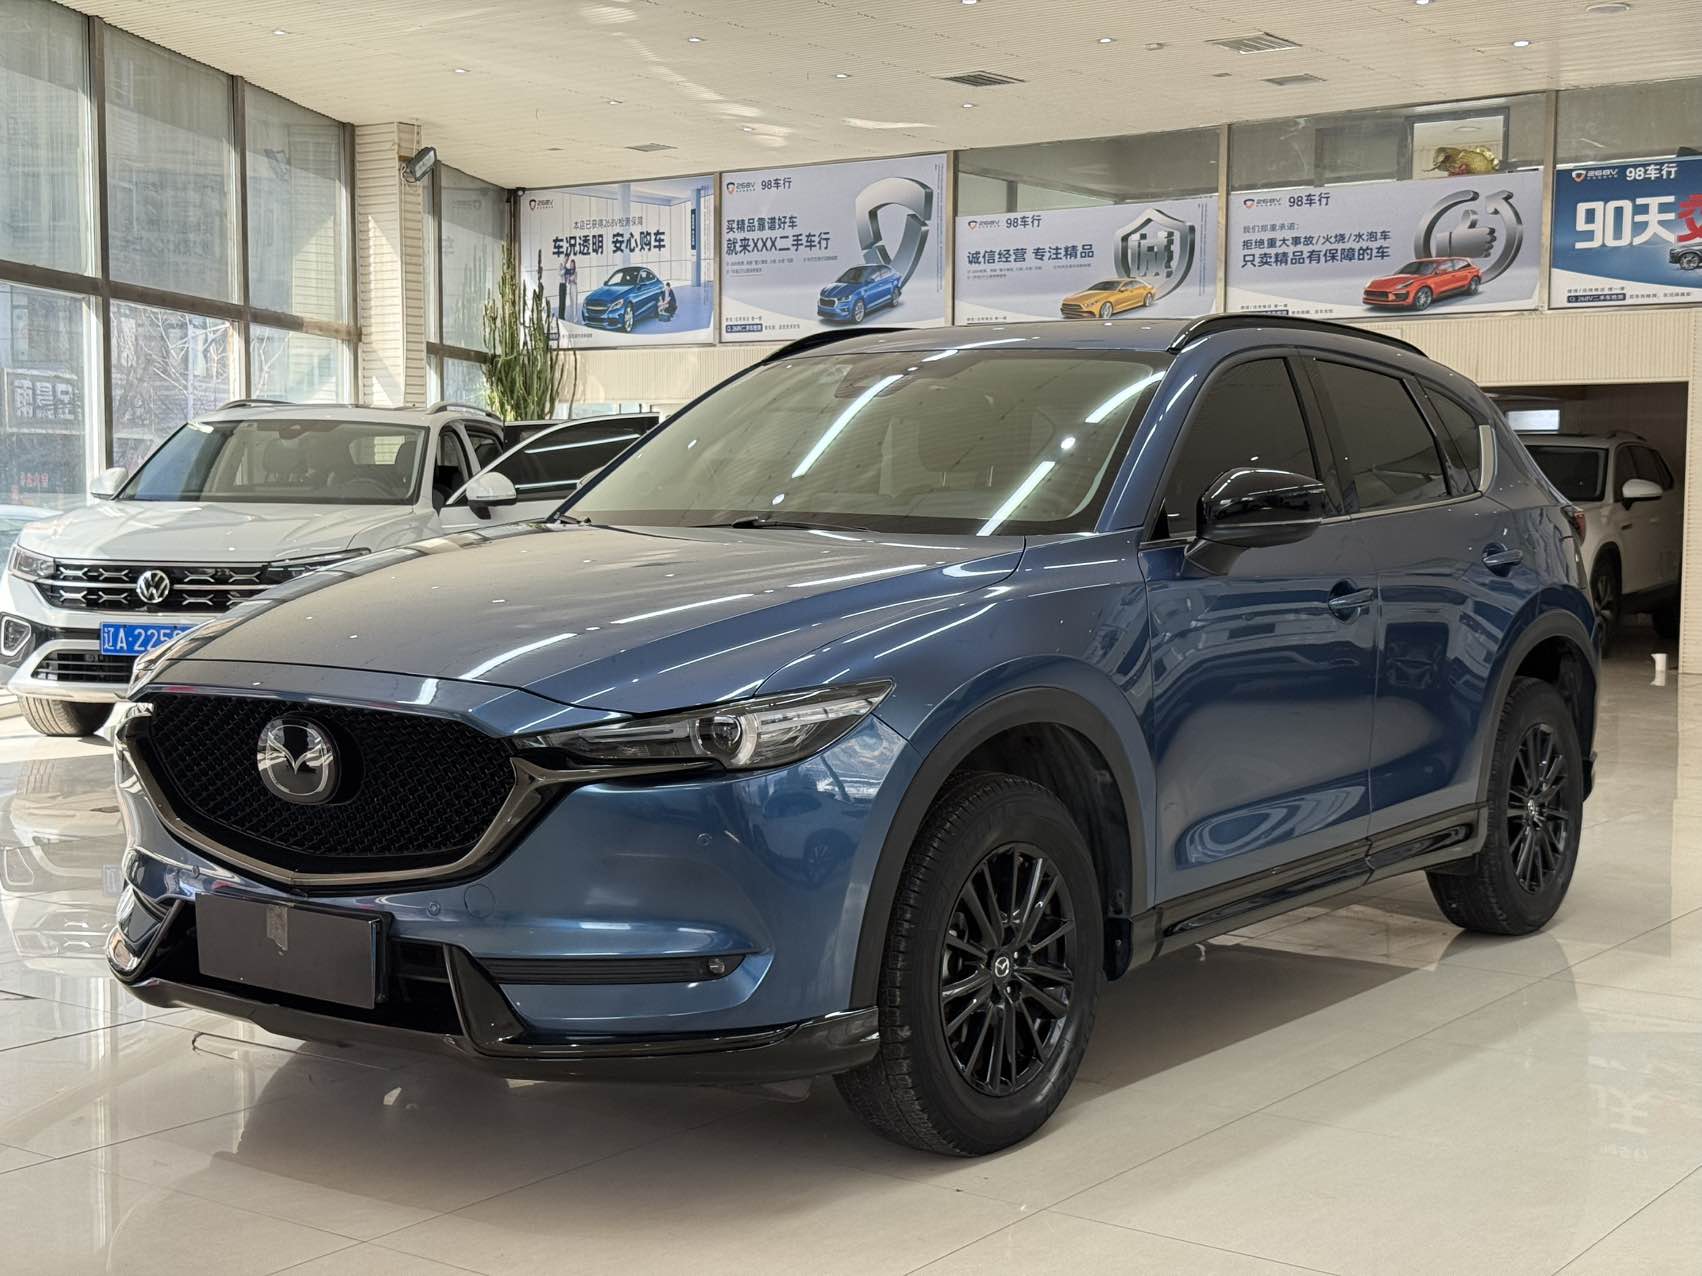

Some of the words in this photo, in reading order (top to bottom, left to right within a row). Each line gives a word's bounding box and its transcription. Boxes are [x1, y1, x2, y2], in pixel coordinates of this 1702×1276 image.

[1626, 163, 1678, 181] 98车行
[761, 177, 792, 190] 98车行
[1288, 192, 1331, 207] 98车行
[726, 215, 798, 234] 买精品靠谱好车
[1005, 214, 1042, 229] 98车行
[552, 234, 604, 258] 车况透明
[612, 229, 666, 254] 安心购车
[726, 232, 830, 255] 就来XXX二手车行
[1241, 230, 1392, 251] 拒绝重大事故/火烧/水泡车
[967, 248, 1027, 266] 诚信经营
[1032, 243, 1095, 262] 专注精品
[1240, 245, 1391, 269] 只卖精品有保障的车
